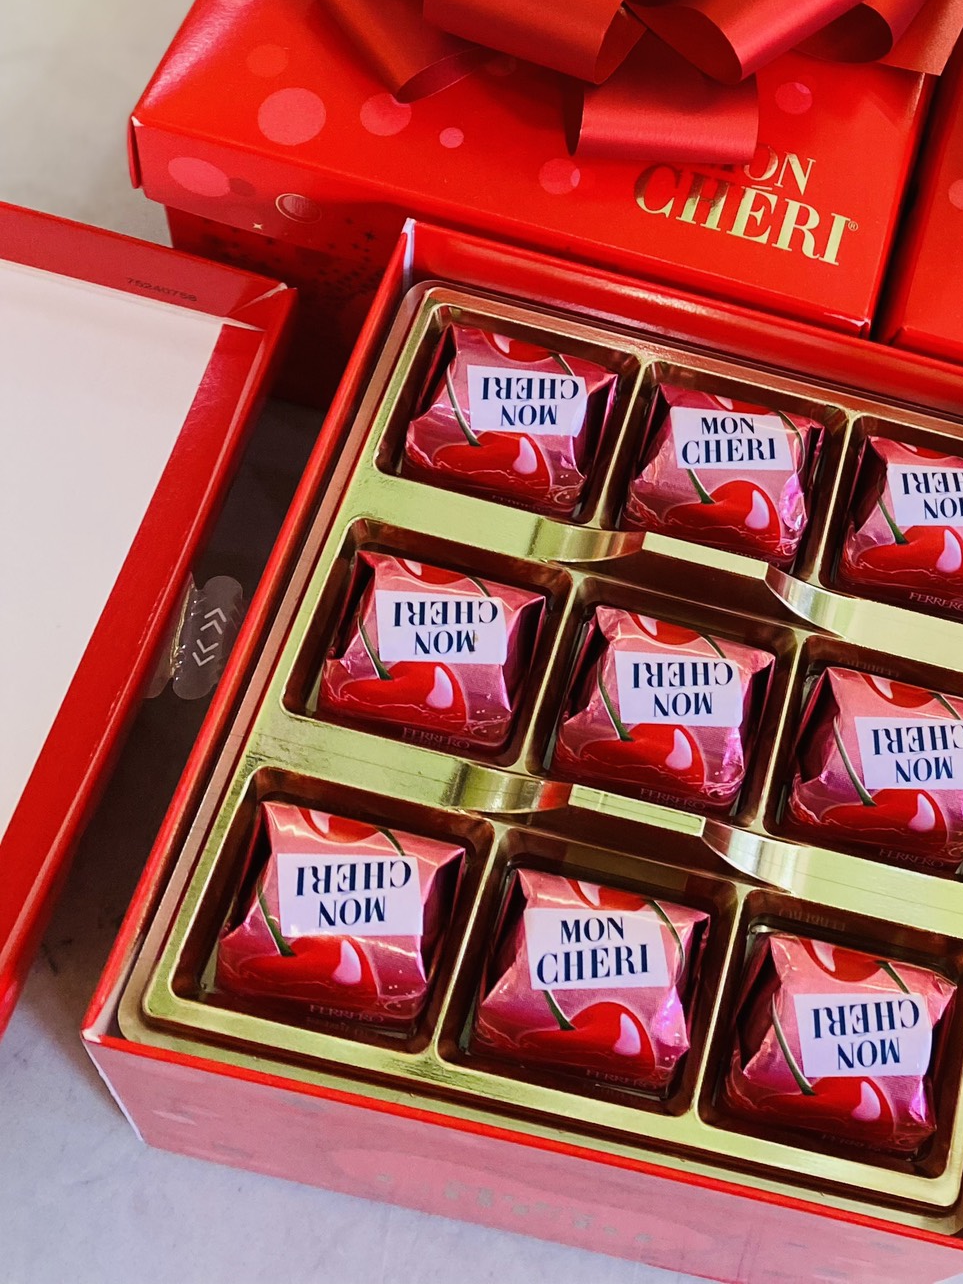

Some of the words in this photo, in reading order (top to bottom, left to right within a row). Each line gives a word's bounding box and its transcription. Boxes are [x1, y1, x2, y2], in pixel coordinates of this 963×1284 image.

[711, 146, 816, 196] ON
[501, 404, 558, 427] MON
[701, 416, 756, 436] MON
[414, 629, 477, 656] MON
[653, 692, 713, 718] MON
[894, 756, 953, 784] MON
[318, 896, 386, 928] MON
[560, 916, 625, 945] MON
[837, 1037, 901, 1071] MON
